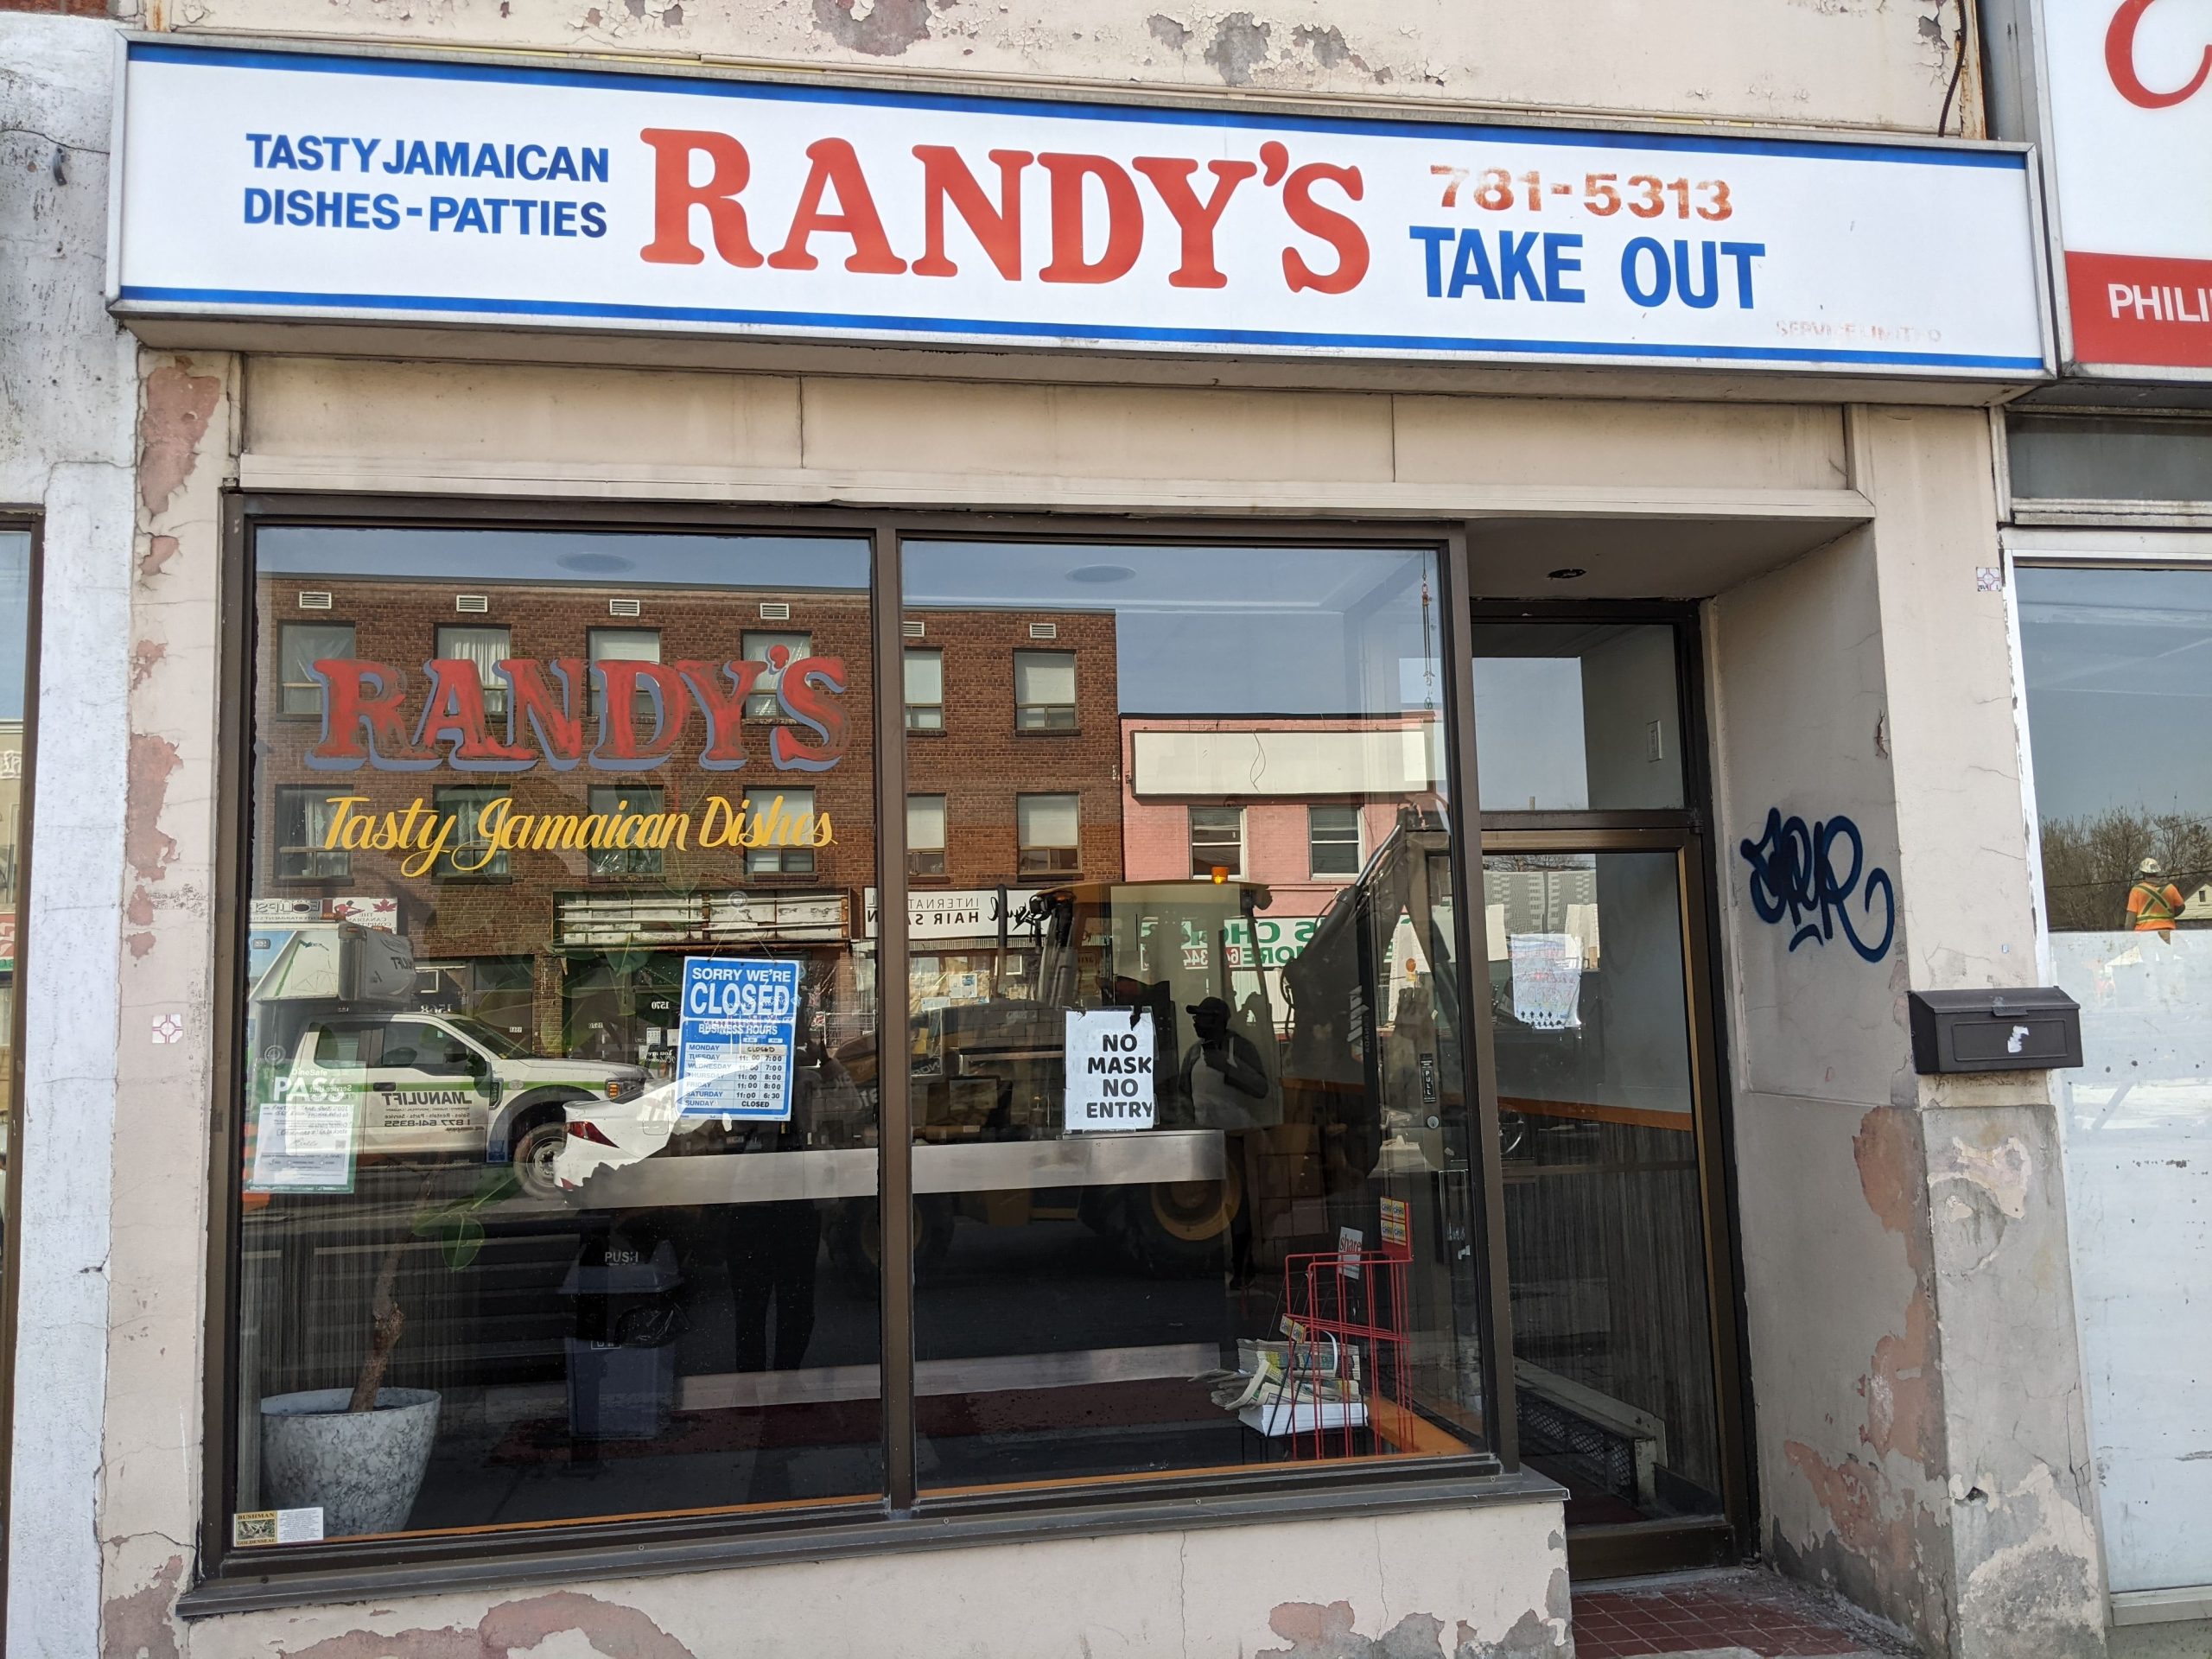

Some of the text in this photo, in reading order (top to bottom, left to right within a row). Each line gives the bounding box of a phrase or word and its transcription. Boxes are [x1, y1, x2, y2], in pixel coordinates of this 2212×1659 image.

[246, 133, 608, 182] TASTY JAMAICAN
[1430, 165, 1732, 221] 781-5313
[640, 127, 1370, 295] RANDY'S
[1409, 226, 1765, 309] TAKE OUT
[2107, 283, 2212, 322] PHILI
[304, 645, 851, 772] RANDY'S
[324, 796, 838, 877] Tasty Jamaican Dishes
[692, 968, 791, 982] SORRY WE'RE
[690, 982, 790, 1016] CLOSED
[698, 1023, 778, 1036] BUSINESS HOURS
[1103, 1033, 1138, 1052] NO
[1088, 1056, 1152, 1074] MASK
[274, 1076, 346, 1103] PASS
[1103, 1078, 1139, 1097] NO
[1086, 1101, 1152, 1118] ENTRY
[1339, 1233, 1363, 1252] share
[605, 1251, 639, 1262] PUSH
